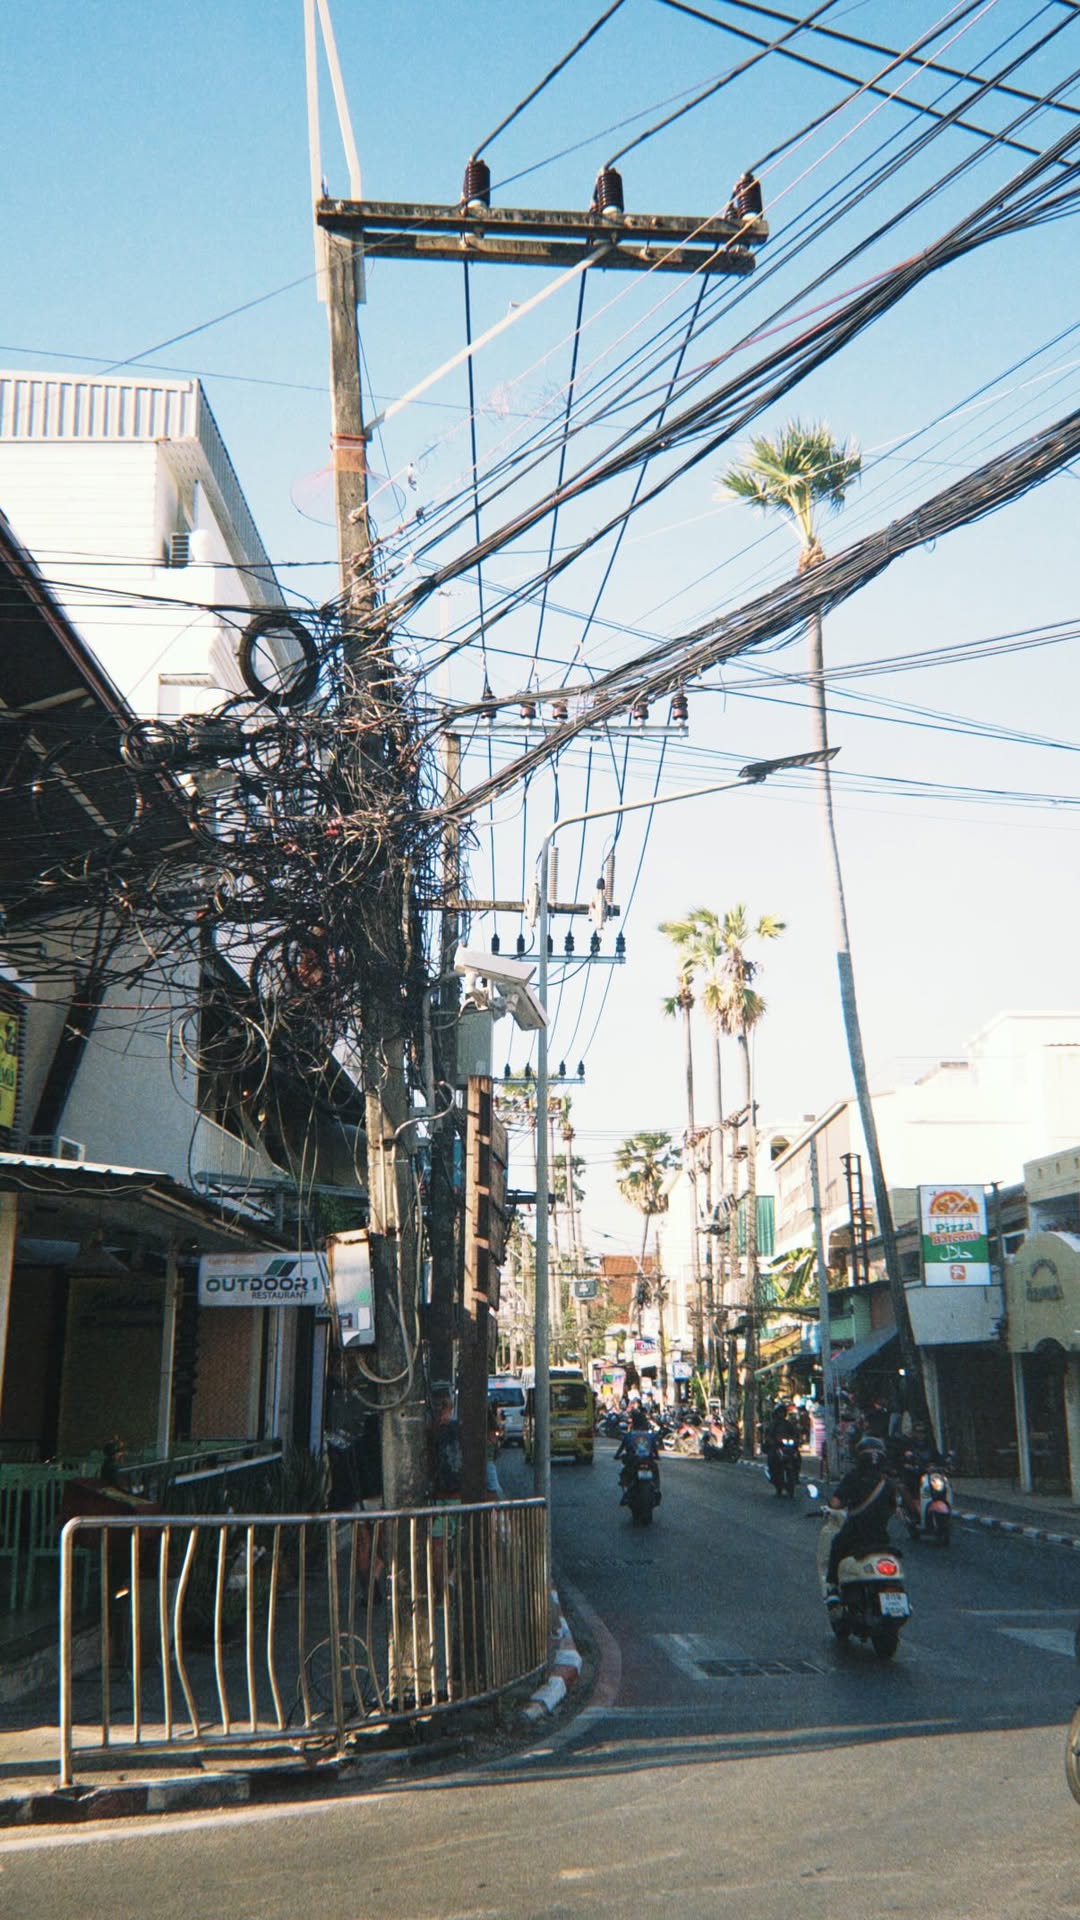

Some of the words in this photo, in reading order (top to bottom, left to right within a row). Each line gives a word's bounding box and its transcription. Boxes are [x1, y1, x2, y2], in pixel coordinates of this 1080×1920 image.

[935, 1222, 974, 1234] Pizza
[940, 1245, 974, 1261] حلال
[206, 1277, 309, 1292] OUTDOOR
[312, 1276, 319, 1290] 1
[251, 1291, 308, 1299] RESTAURANT
